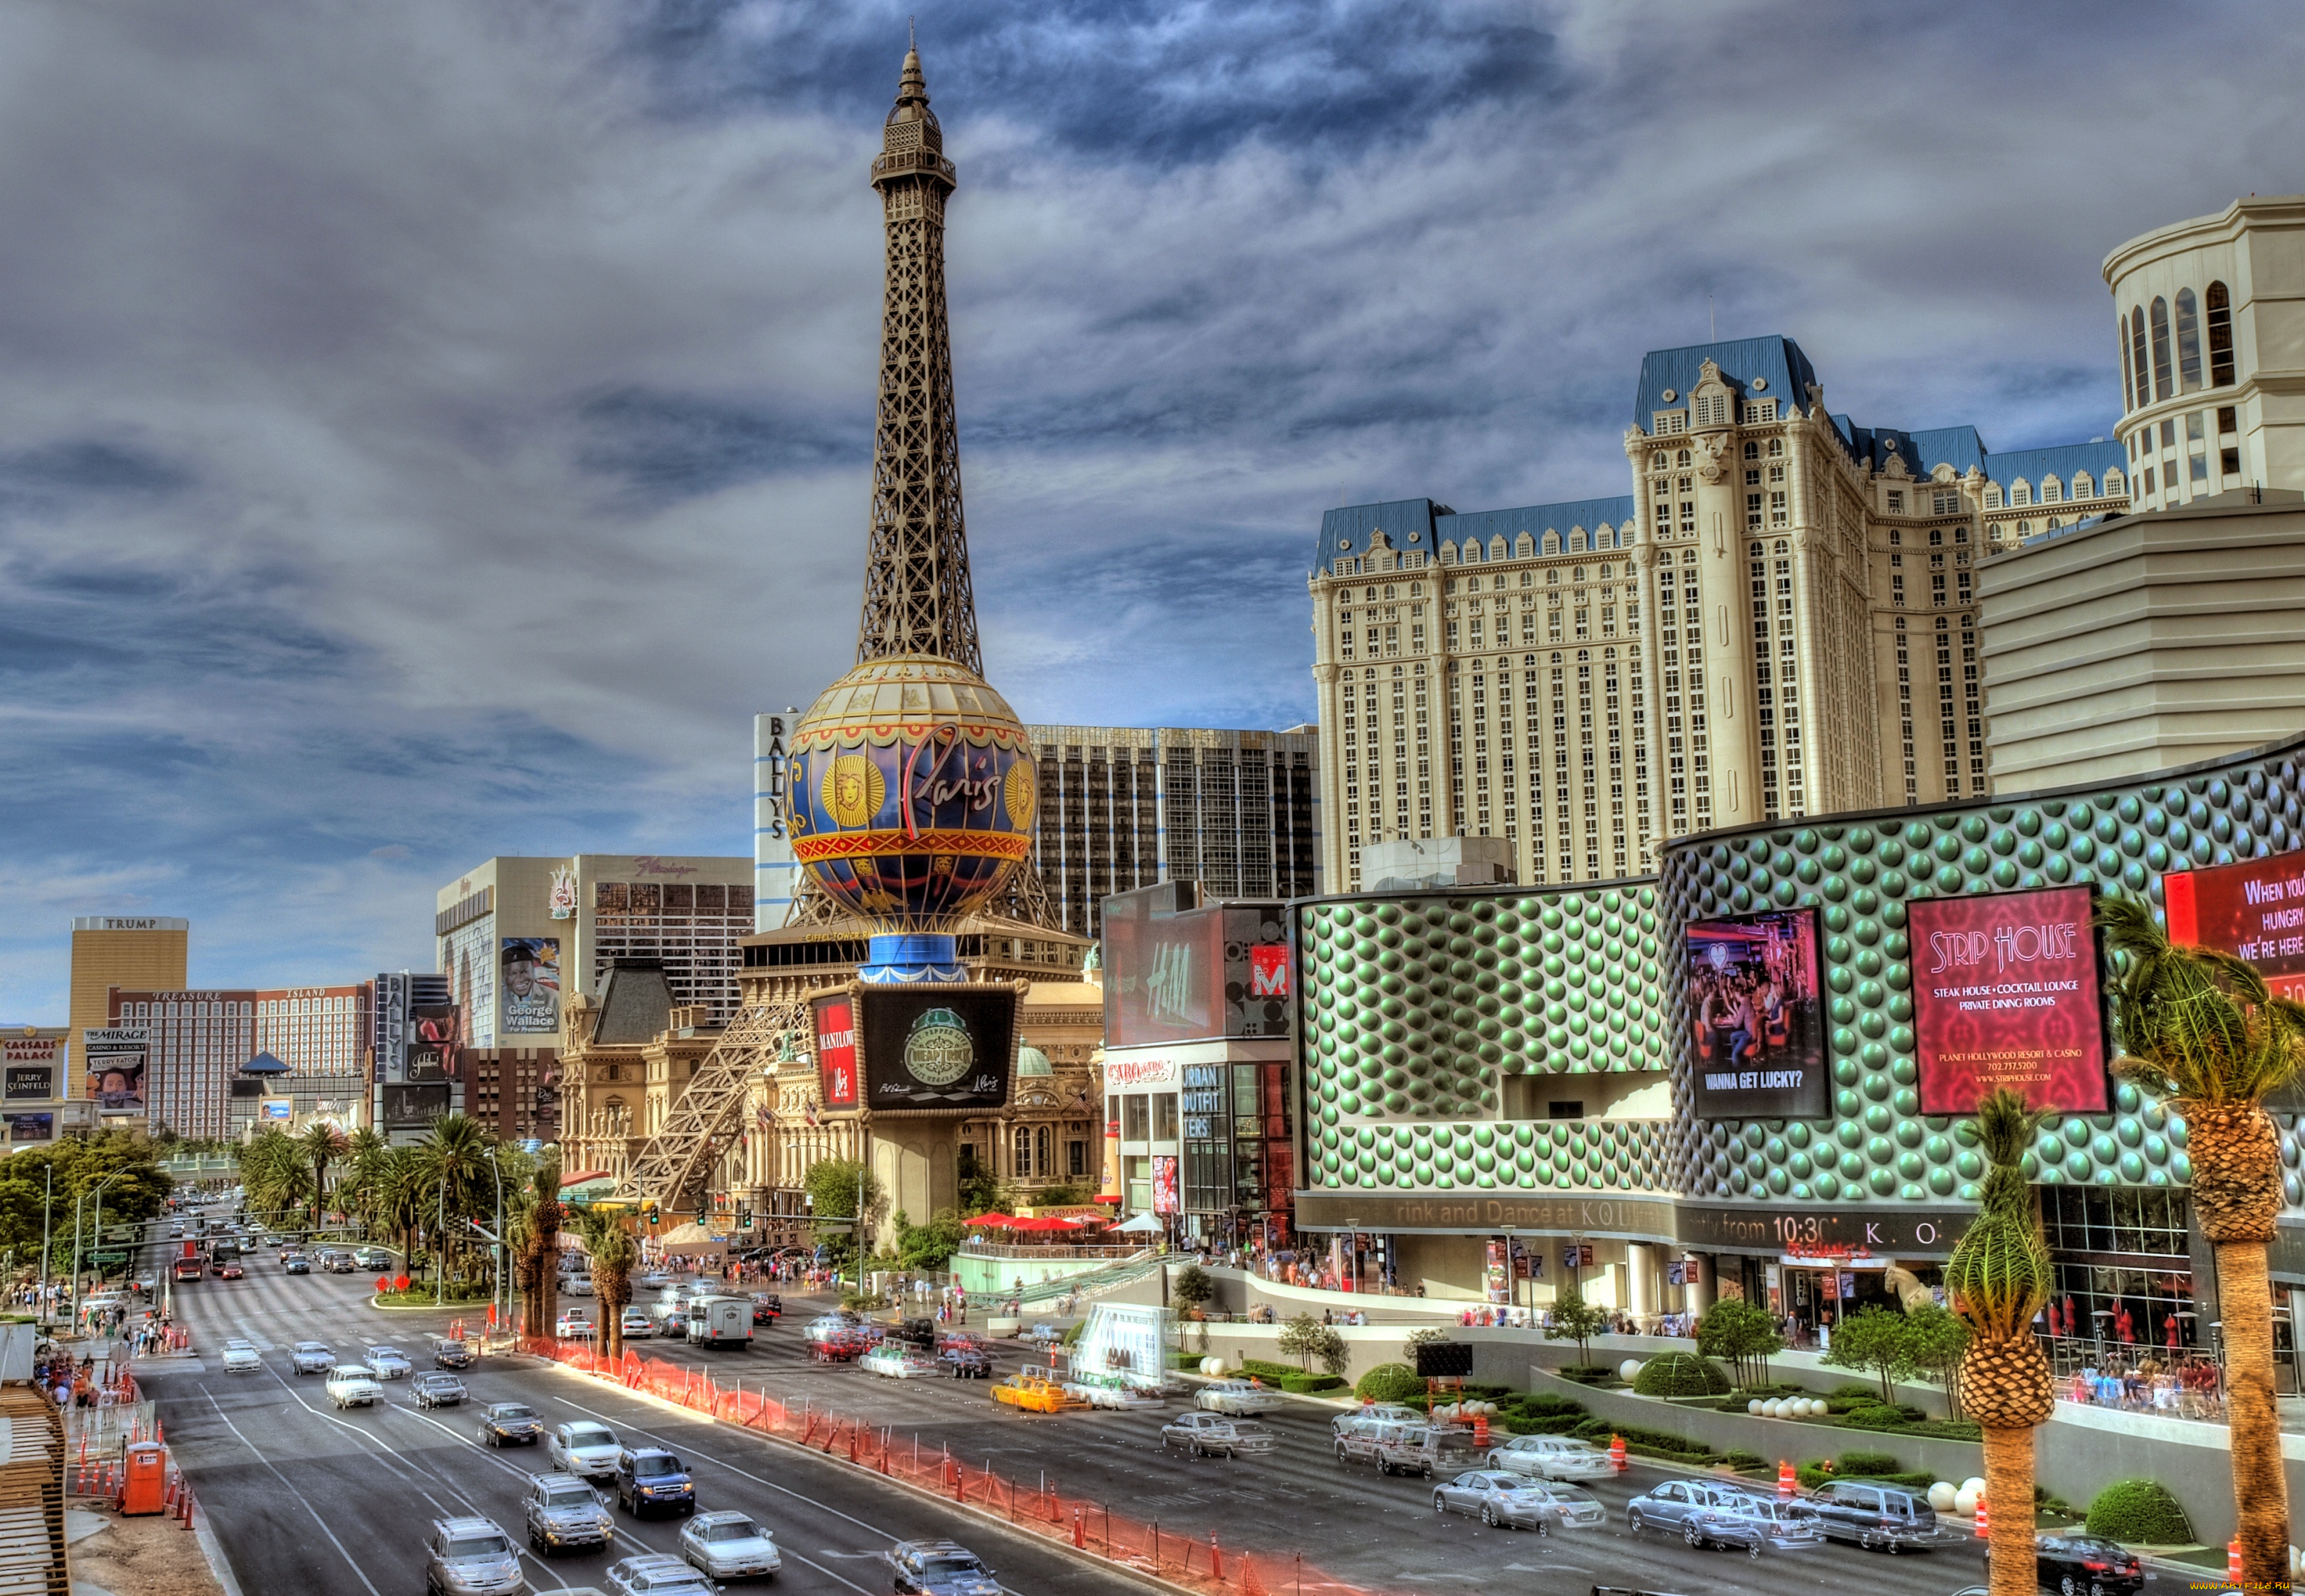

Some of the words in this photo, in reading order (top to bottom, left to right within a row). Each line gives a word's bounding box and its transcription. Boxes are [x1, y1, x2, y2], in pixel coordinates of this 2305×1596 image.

[903, 722, 1002, 840] Paris
[634, 856, 698, 879] Flamingo
[107, 919, 156, 929] TRUMP
[834, 931, 860, 941] TOWER
[1930, 931, 1989, 974] STRIP
[1994, 923, 2076, 974] HOUSE
[2238, 935, 2276, 961] WE'RE
[153, 991, 221, 1000] TREASURE
[286, 988, 326, 998] ISLAND
[1933, 987, 1960, 998] STEAK
[1962, 985, 1992, 996] HOUSE
[1996, 981, 2042, 994] COCKTAIL
[2044, 980, 2078, 992] LOUNGE
[1959, 1000, 1991, 1011] PRIVATE
[1992, 998, 2022, 1009] DINING
[2024, 997, 2055, 1007] ROOMS
[508, 1005, 552, 1017] George
[506, 1016, 555, 1026] Wallace
[93, 1030, 147, 1040] MIRAGE
[925, 1028, 954, 1037] PEPPER
[5, 1040, 56, 1050] CAESARS
[819, 1029, 854, 1050] MANILOW
[7, 1051, 53, 1060] PALACE
[1939, 1052, 1966, 1062] PLANET
[1967, 1050, 2016, 1061] HOLLYWOOD
[2017, 1050, 2044, 1060] RESORT
[2046, 1050, 2052, 1059] &
[2055, 1048, 2082, 1058] CASINO
[17, 1073, 42, 1083] JERRY
[1705, 1073, 1737, 1090] WANNA
[1739, 1072, 1758, 1089] GET
[1759, 1070, 1803, 1089] LUCKY?
[7, 1082, 50, 1092] SEINFELD
[1183, 1092, 1219, 1112] OUTFIT
[1184, 1118, 1207, 1137] TERS
[1441, 1201, 1478, 1222] and
[1487, 1201, 1550, 1223] Dance
[1558, 1203, 1574, 1224] at
